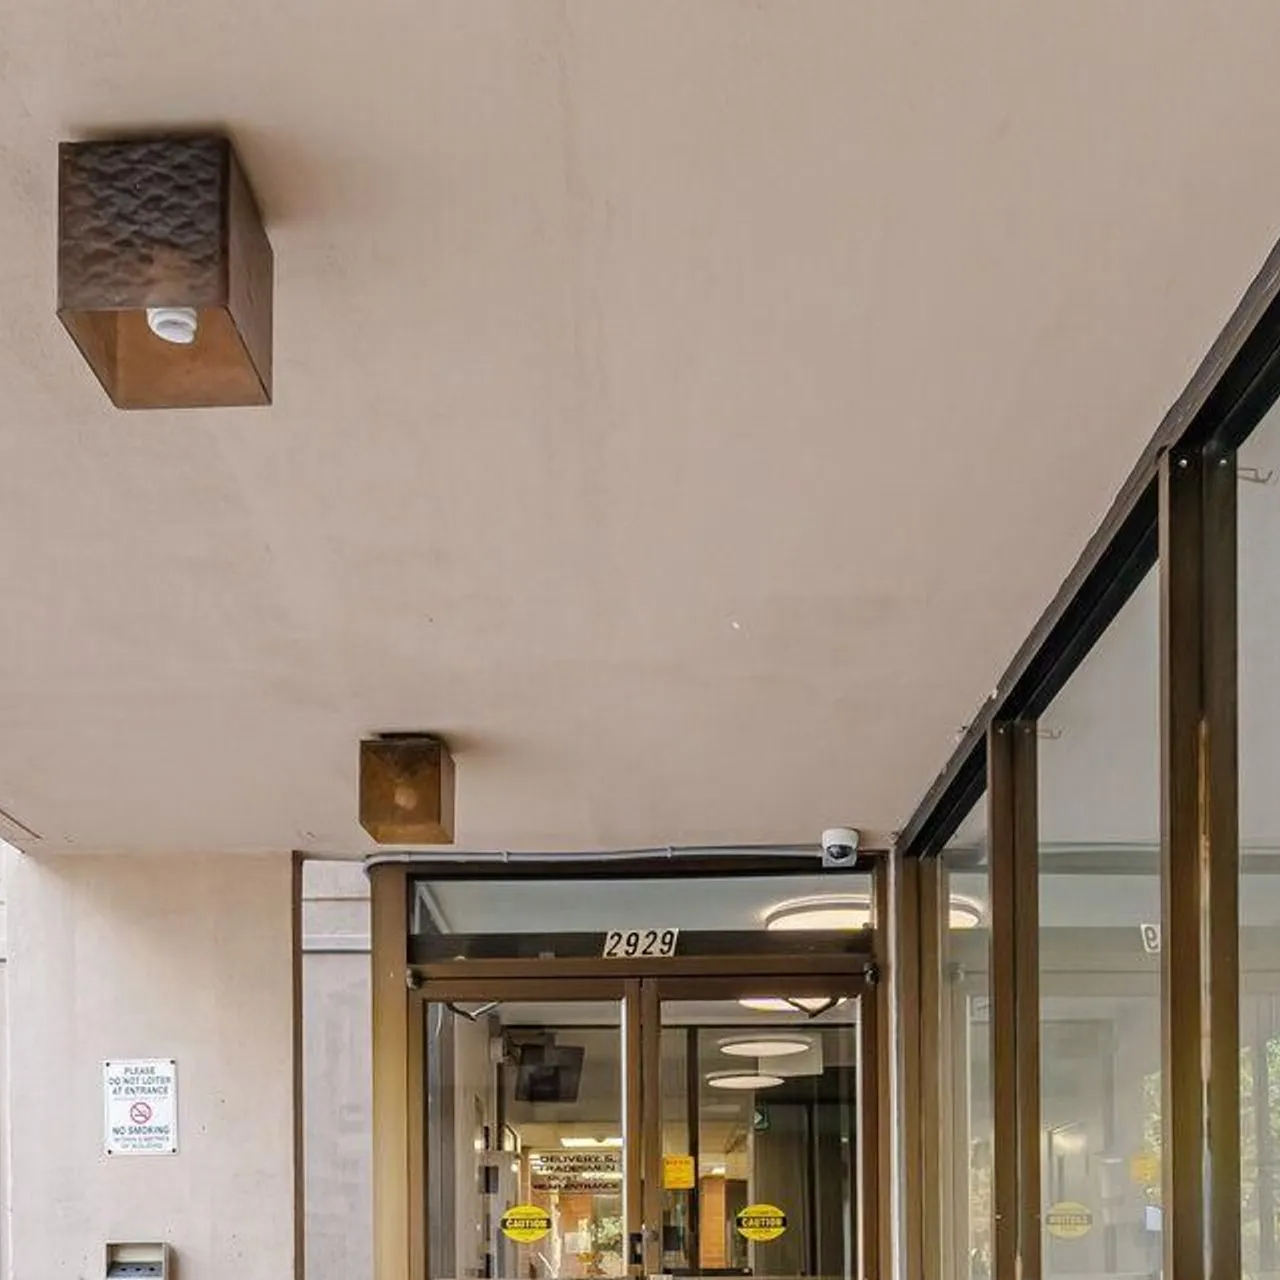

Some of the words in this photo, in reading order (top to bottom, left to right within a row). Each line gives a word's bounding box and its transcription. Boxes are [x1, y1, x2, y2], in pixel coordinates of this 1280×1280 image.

[606, 931, 675, 957] 2929
[124, 1066, 156, 1075] PLEASE
[123, 1076, 140, 1085] NOT
[124, 1086, 169, 1095] ENTRANCE
[112, 1126, 126, 1135] NO
[128, 1125, 170, 1135] SMOKING
[506, 1218, 547, 1228] CAUTION
[741, 1217, 783, 1228] CAUTION
